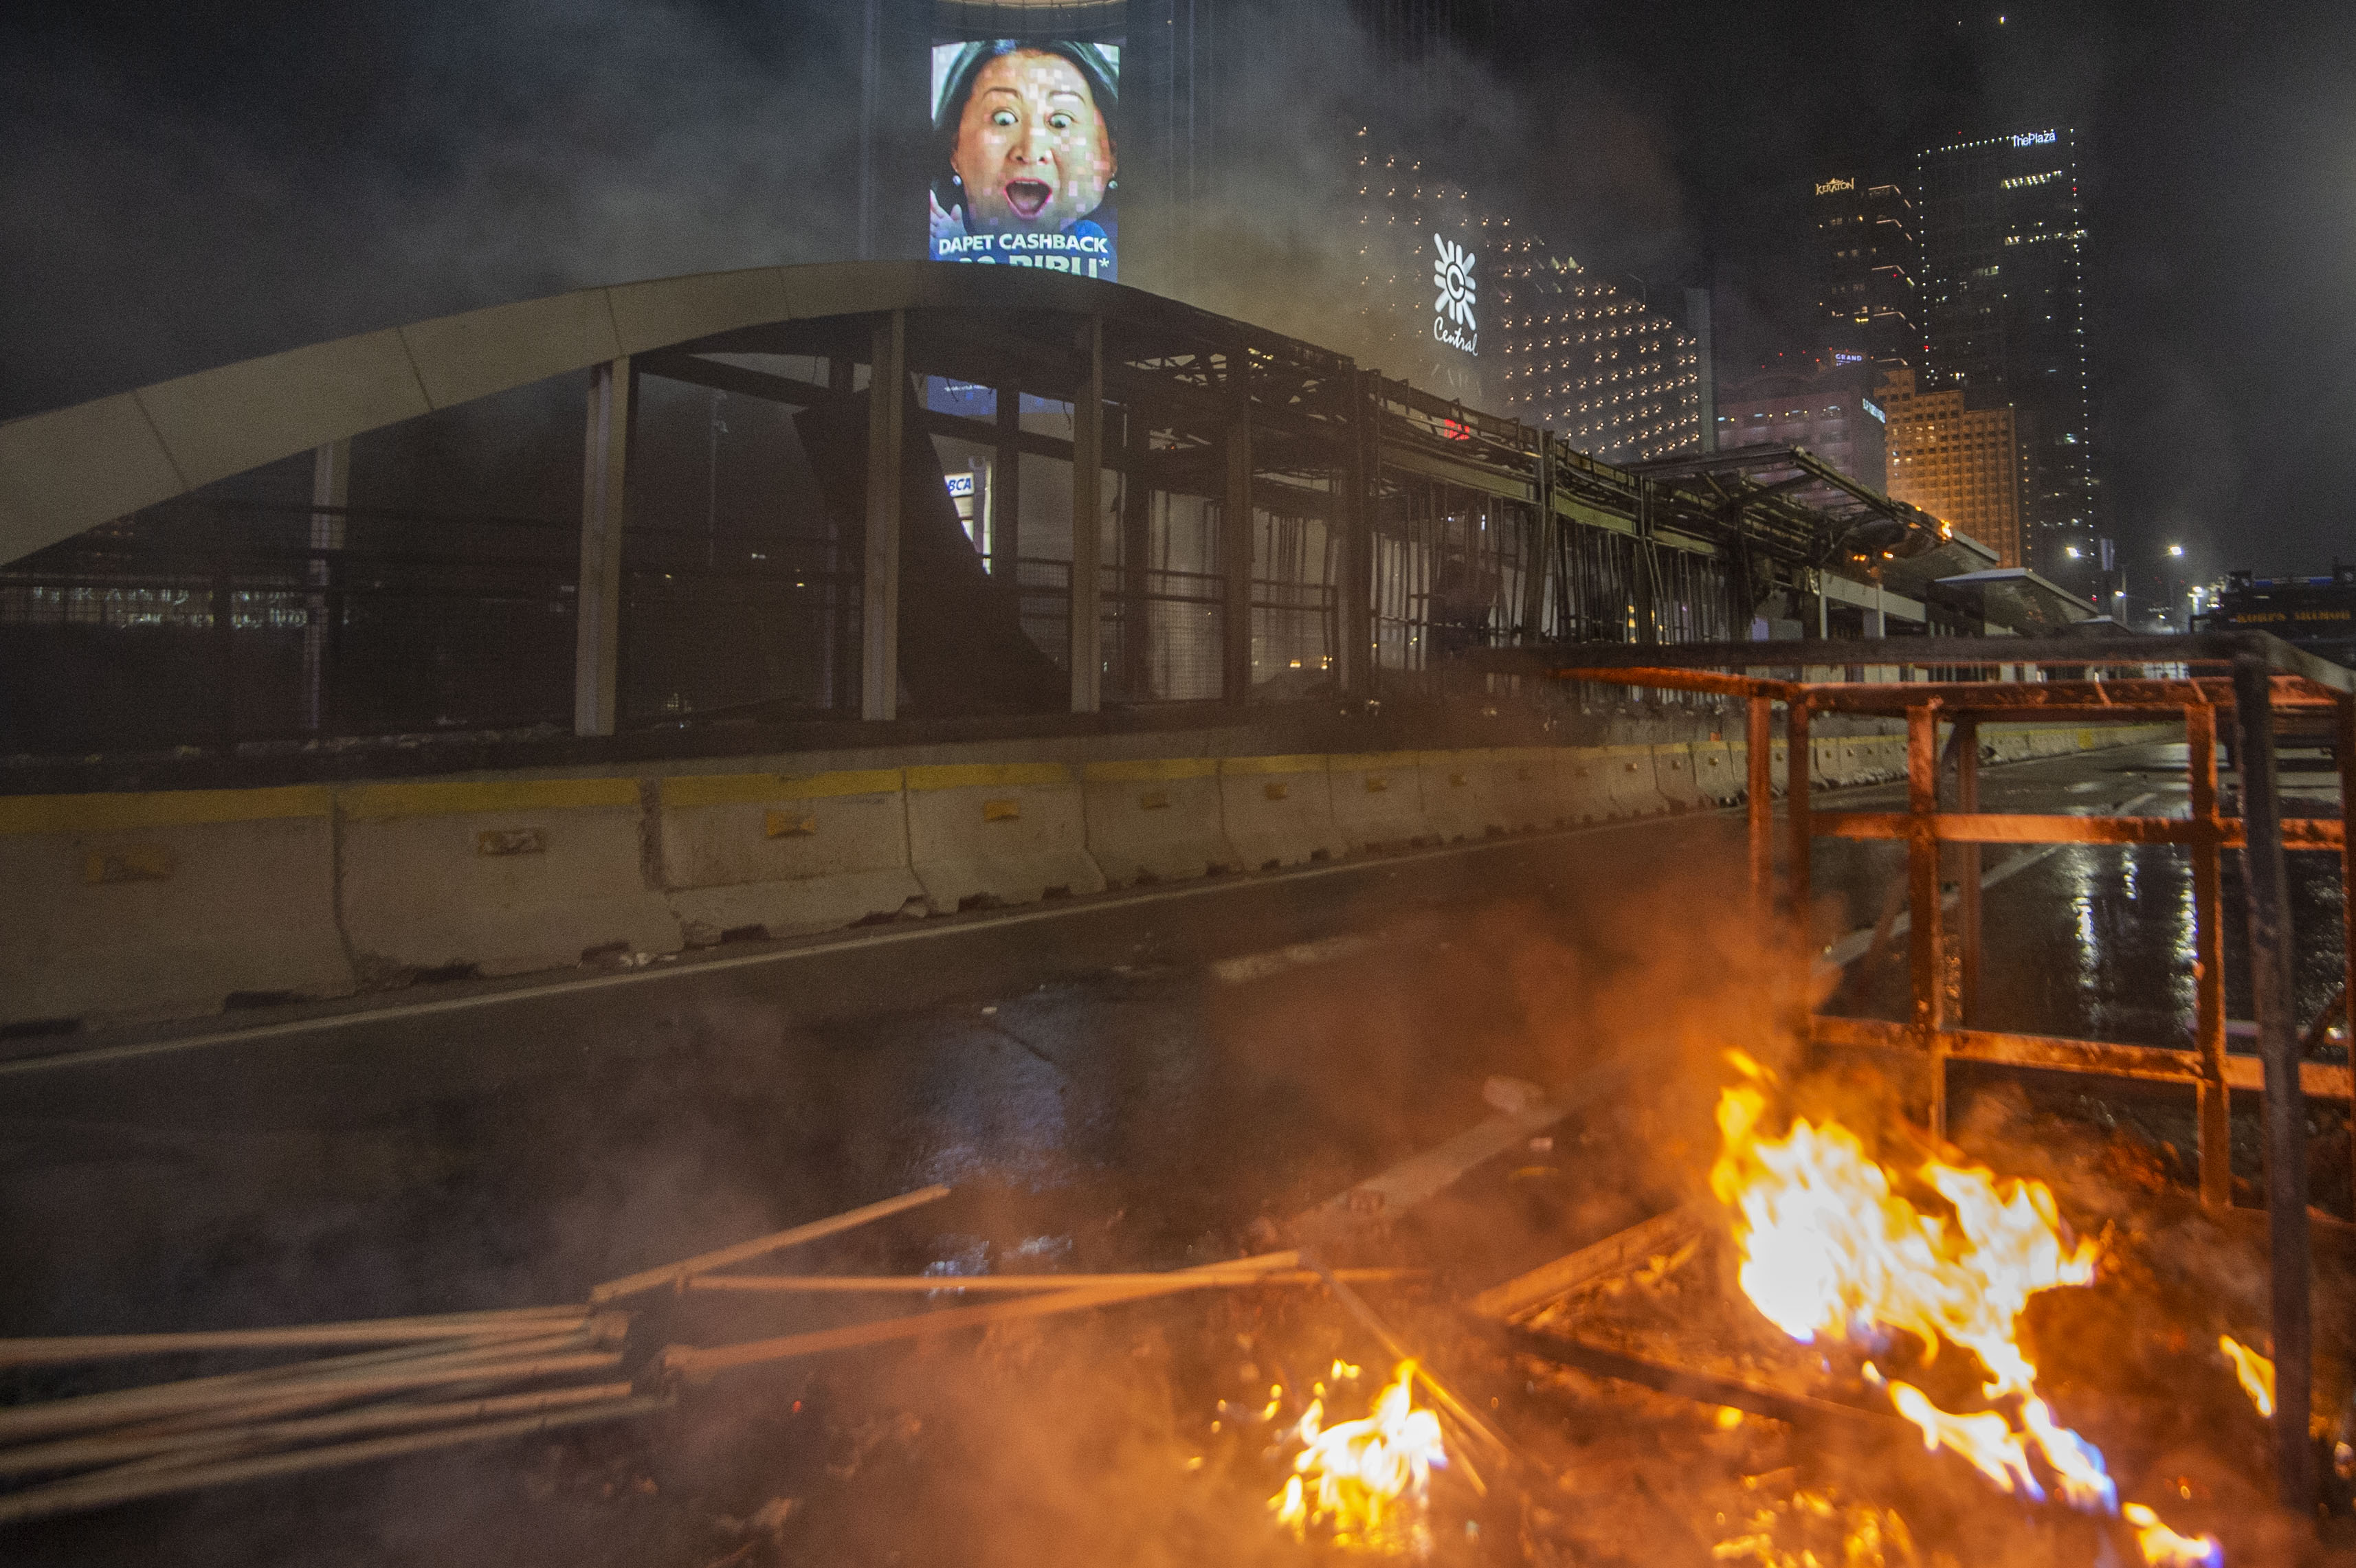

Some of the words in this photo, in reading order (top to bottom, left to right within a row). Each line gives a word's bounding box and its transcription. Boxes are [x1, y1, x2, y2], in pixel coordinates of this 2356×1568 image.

[1815, 177, 1854, 196] KERATON
[939, 234, 994, 255] DAPET
[999, 234, 1108, 253] CASHBACK
[1434, 316, 1478, 357] Central
[1836, 353, 1862, 361] GRAND
[948, 478, 972, 491] BCA
